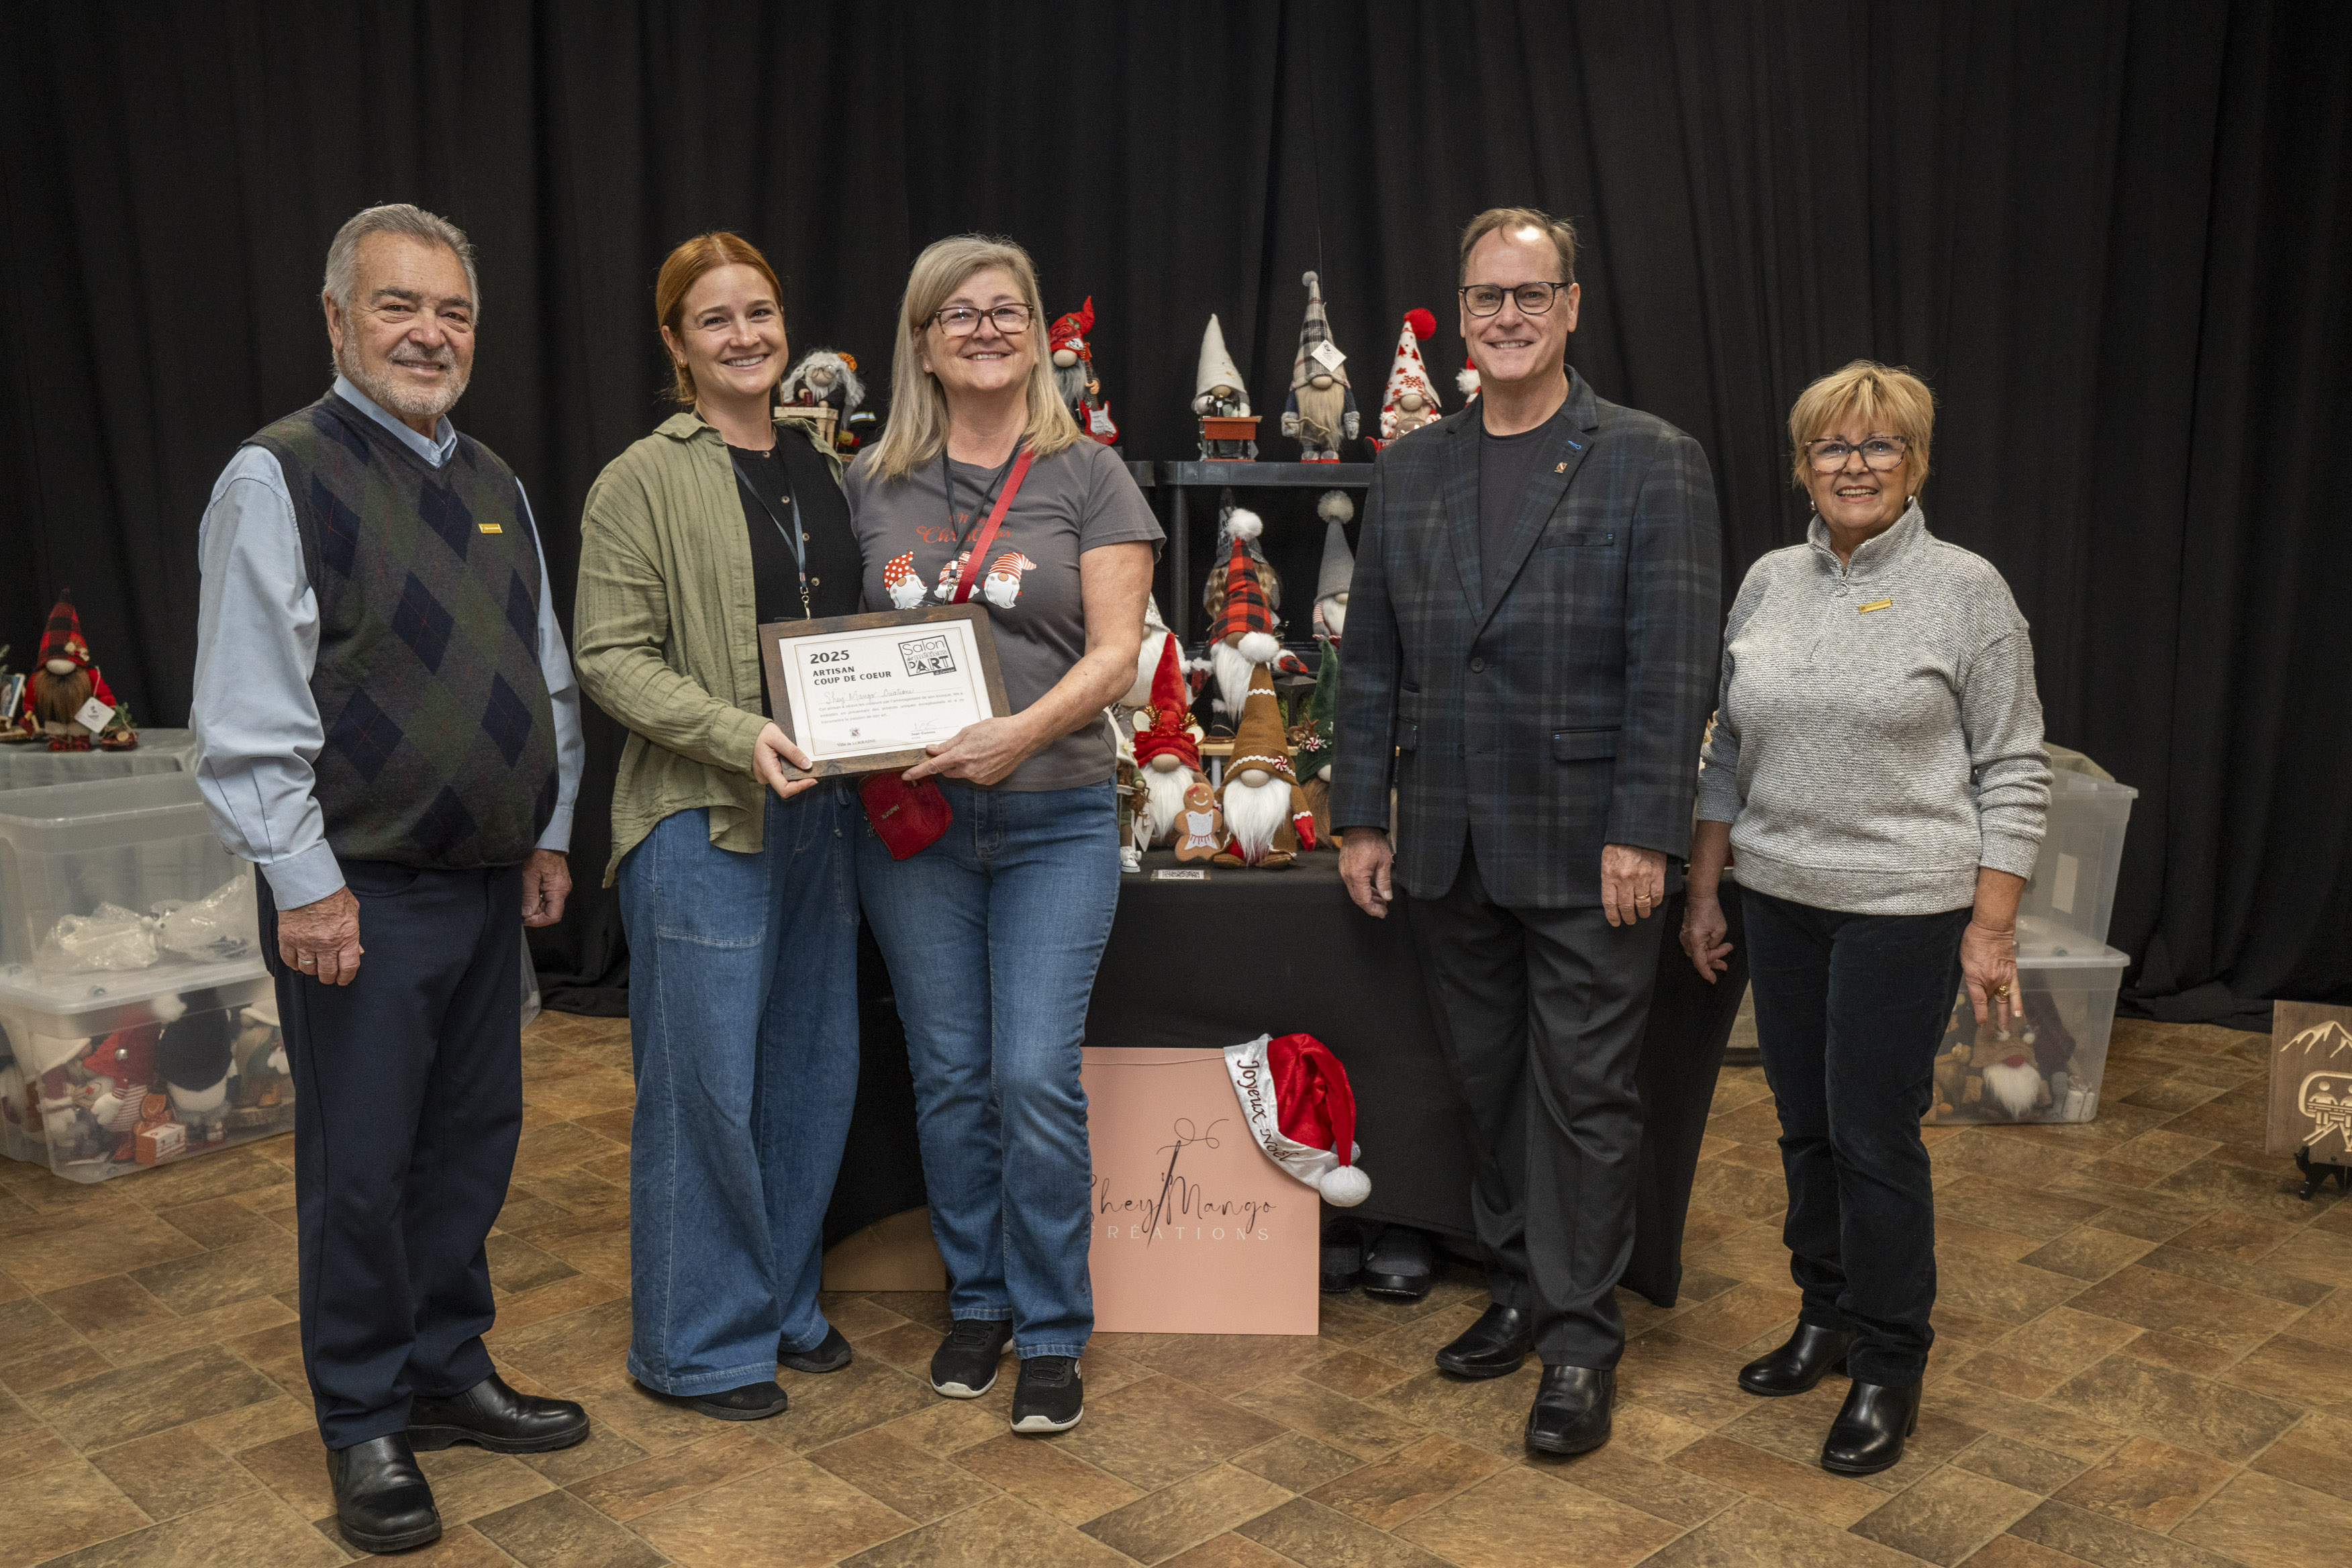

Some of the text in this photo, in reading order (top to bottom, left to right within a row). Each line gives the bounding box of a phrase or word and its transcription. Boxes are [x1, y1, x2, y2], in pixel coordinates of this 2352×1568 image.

[902, 640, 945, 655] Salon
[810, 650, 850, 664] 2025
[914, 650, 947, 660] métiers
[908, 655, 948, 673] D'ART
[813, 667, 854, 677] ARTISAN
[814, 677, 840, 685] COUP
[860, 671, 891, 681] COEUR
[1237, 1060, 1300, 1162] Joyeux Noël
